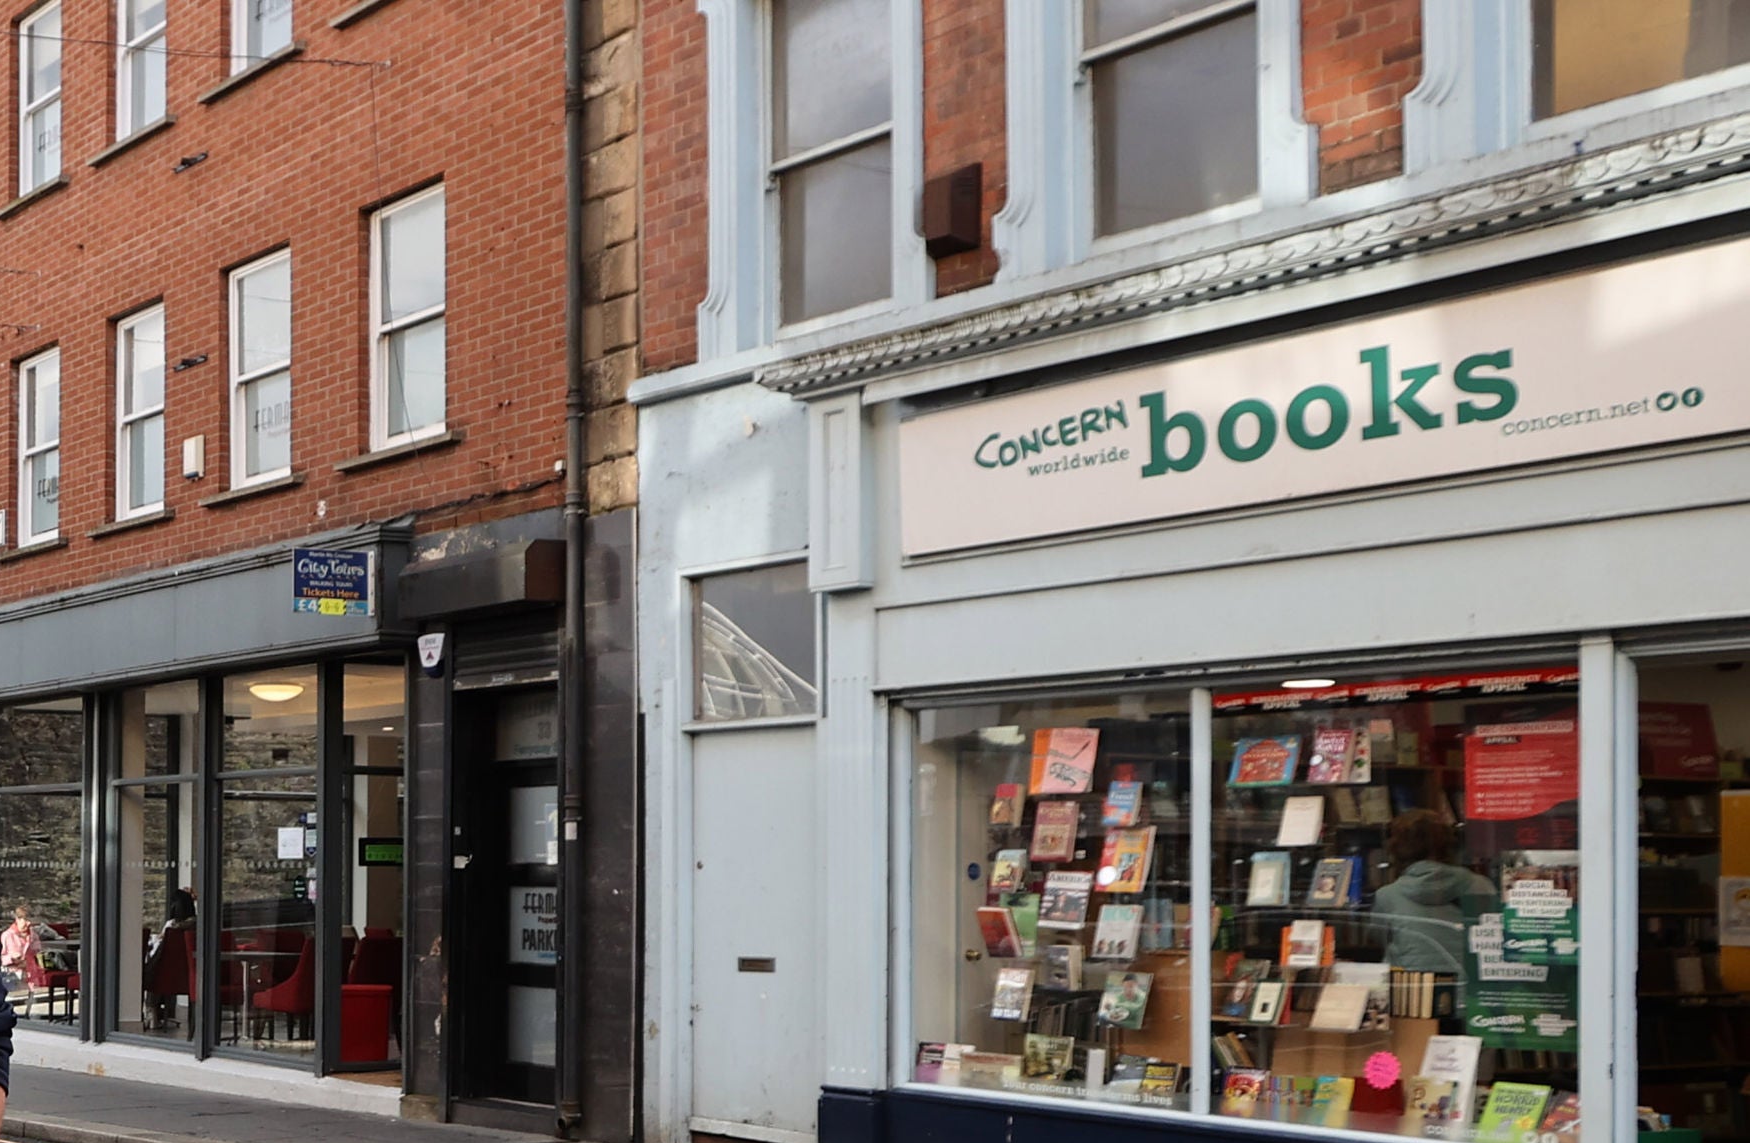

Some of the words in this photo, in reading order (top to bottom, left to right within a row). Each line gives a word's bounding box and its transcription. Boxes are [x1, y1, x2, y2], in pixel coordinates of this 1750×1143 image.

[1137, 342, 1520, 479] books
[1501, 396, 1650, 436] concern.net
[974, 399, 1130, 468] CONCERN
[1027, 446, 1130, 476] worldwide
[297, 558, 329, 578] City
[327, 560, 365, 576] Tours
[302, 587, 335, 597] Tickets
[336, 589, 360, 598] Here
[1480, 682, 1529, 693] APPEAL
[1484, 967, 1544, 977] ENTERING
[1028, 1083, 1075, 1095] concern
[1143, 1092, 1173, 1106] lives
